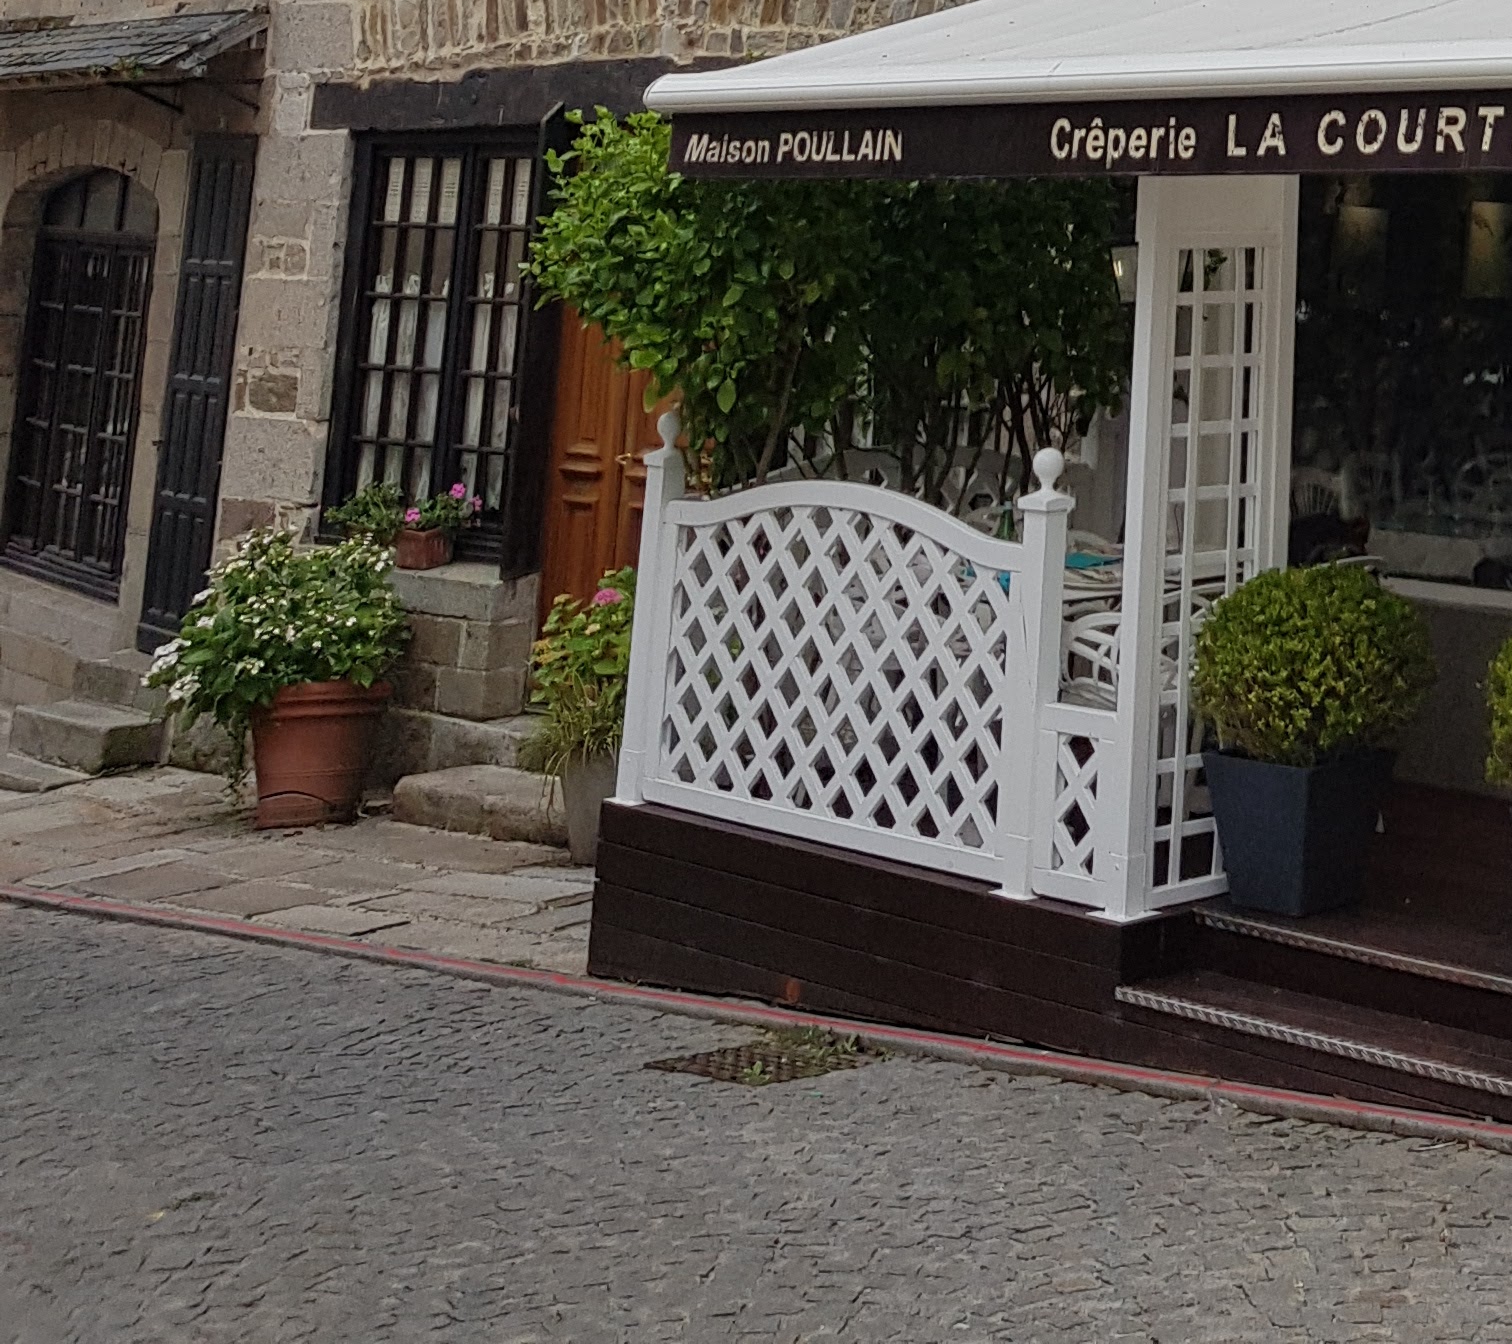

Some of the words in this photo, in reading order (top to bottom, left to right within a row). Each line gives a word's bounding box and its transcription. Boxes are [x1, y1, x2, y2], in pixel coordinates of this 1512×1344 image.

[684, 133, 770, 162] Maison
[776, 129, 902, 164] POULLAIN
[1050, 117, 1196, 169] Crêperie
[1226, 113, 1286, 156] LA
